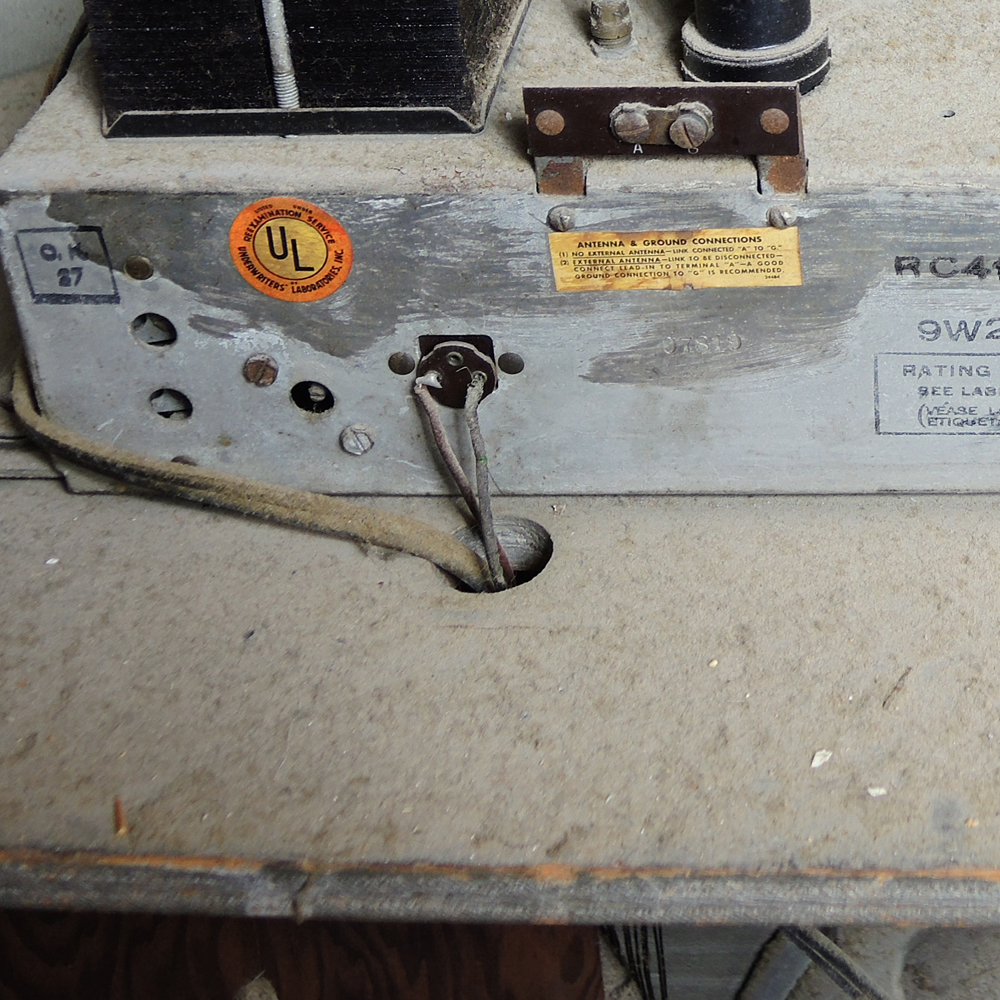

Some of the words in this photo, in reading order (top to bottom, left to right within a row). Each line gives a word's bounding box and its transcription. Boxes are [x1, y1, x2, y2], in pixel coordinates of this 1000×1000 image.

[632, 144, 642, 154] A
[243, 208, 302, 242] REEXAMINATION
[307, 216, 336, 244] SERVICE
[578, 240, 625, 248] ANTENNA
[643, 238, 686, 246] GROUND
[692, 236, 762, 244] CONNECTIONS
[266, 226, 314, 272] UL
[902, 364, 992, 379] RATING
[918, 386, 954, 398] SEE
